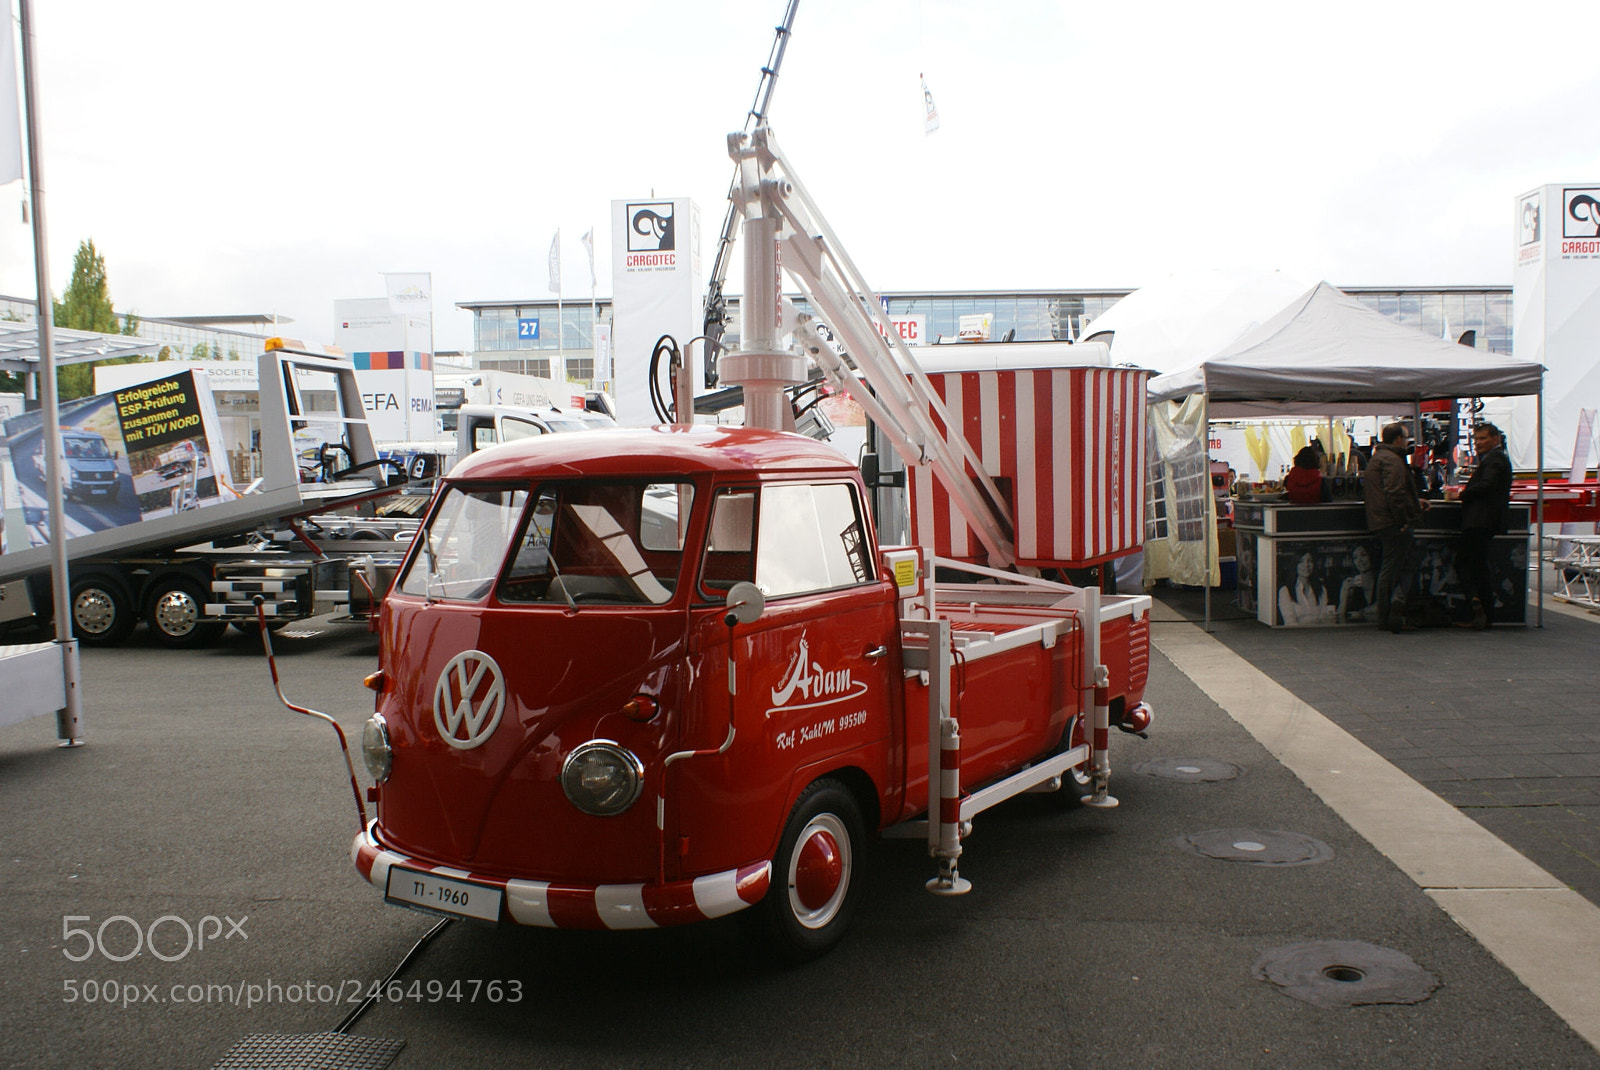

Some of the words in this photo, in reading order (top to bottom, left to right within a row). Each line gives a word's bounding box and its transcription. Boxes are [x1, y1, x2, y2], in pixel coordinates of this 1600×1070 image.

[1562, 242, 1600, 253] CARGOT
[627, 254, 675, 267] CARGOTEC
[520, 322, 537, 336] 27
[208, 368, 254, 376] SOCIETE
[116, 381, 180, 404] Erfolgreiche
[119, 393, 187, 417] ESP-Prüfung
[411, 397, 432, 413] PEMA
[123, 408, 180, 430] zusammen
[126, 430, 144, 442] mit
[145, 421, 167, 437] TÜV
[169, 414, 200, 431] NORD
[771, 630, 852, 706] Adam
[776, 730, 796, 749] Ruf
[839, 710, 867, 731] 995500
[413, 881, 426, 897] T1
[438, 886, 470, 906] 1960
